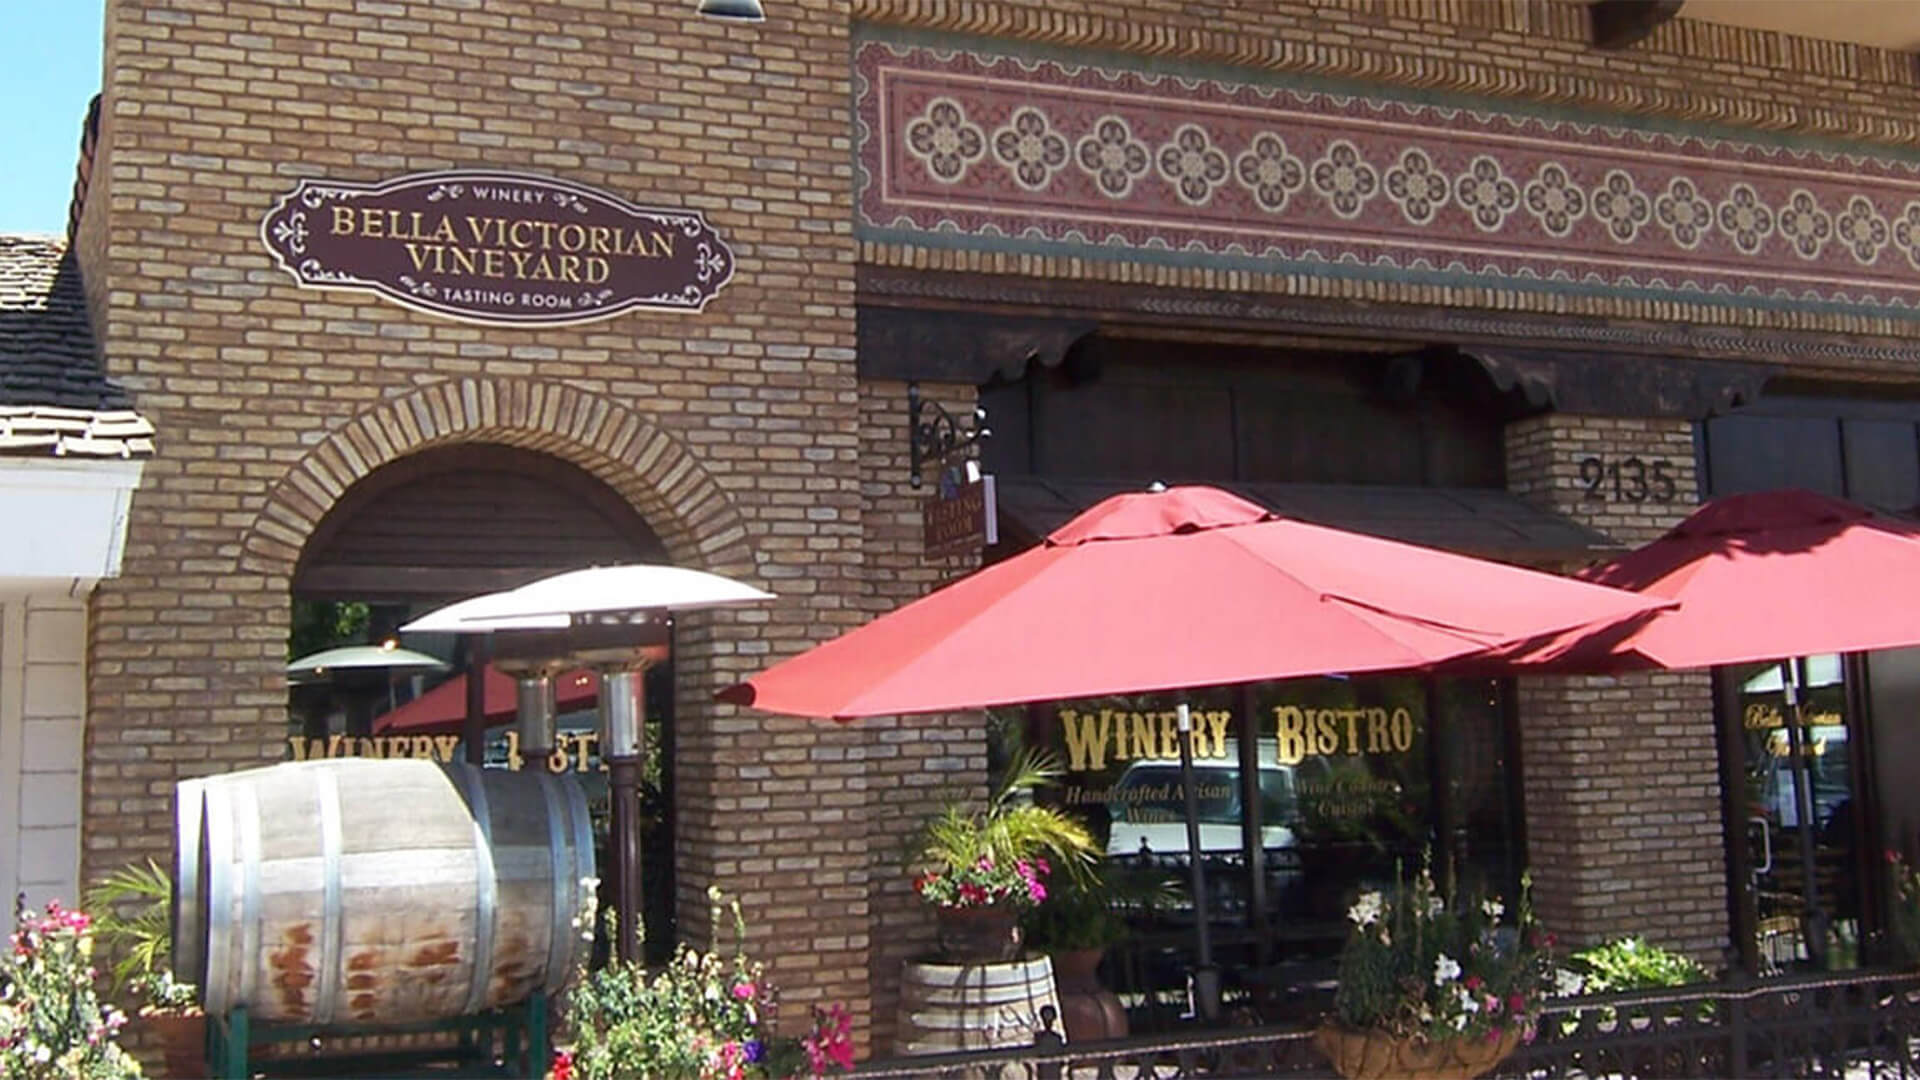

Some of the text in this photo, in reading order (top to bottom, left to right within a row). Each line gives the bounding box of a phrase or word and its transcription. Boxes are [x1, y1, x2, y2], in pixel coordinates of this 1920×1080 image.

[472, 186, 545, 204] WINERY
[330, 207, 676, 258] BELLA VICTORIAN
[405, 244, 610, 283] VINEYARD
[443, 287, 573, 309] TASTING ROOM
[1581, 457, 1675, 500] 2135
[1059, 705, 1415, 771] WINERY BISTRO
